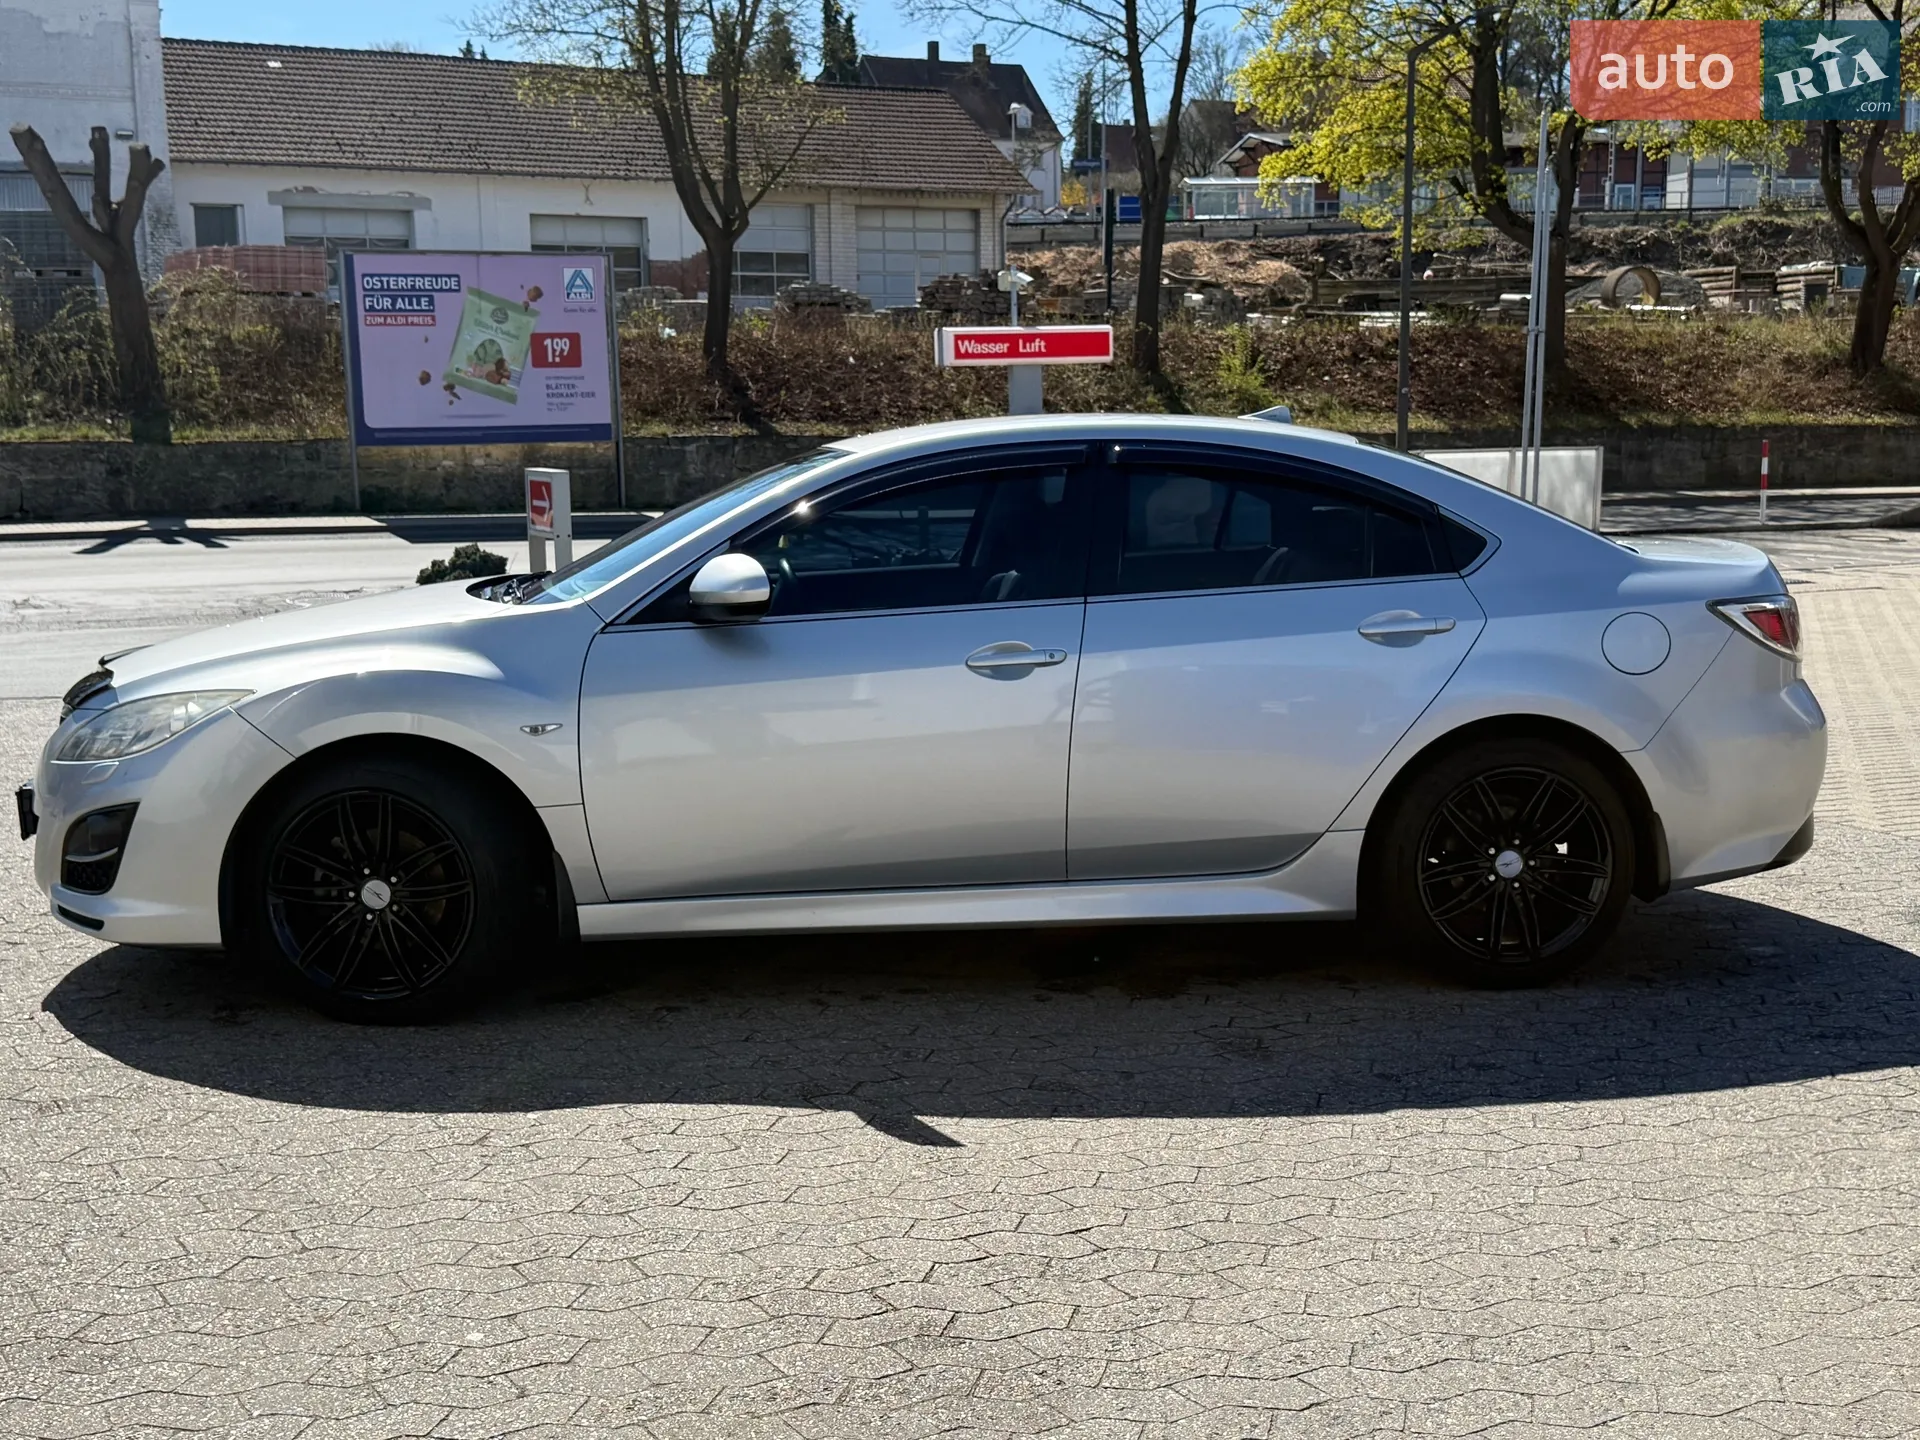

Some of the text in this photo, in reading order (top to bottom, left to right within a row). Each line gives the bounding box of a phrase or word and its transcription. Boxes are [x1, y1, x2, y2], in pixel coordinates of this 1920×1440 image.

[363, 276, 460, 290] OSTERFREUDE
[365, 294, 434, 310] FÜR ALLE.
[569, 292, 592, 300] ALDI
[366, 315, 435, 326] ZUM ALDI PREIS.
[957, 338, 1047, 354] Wasser Luft
